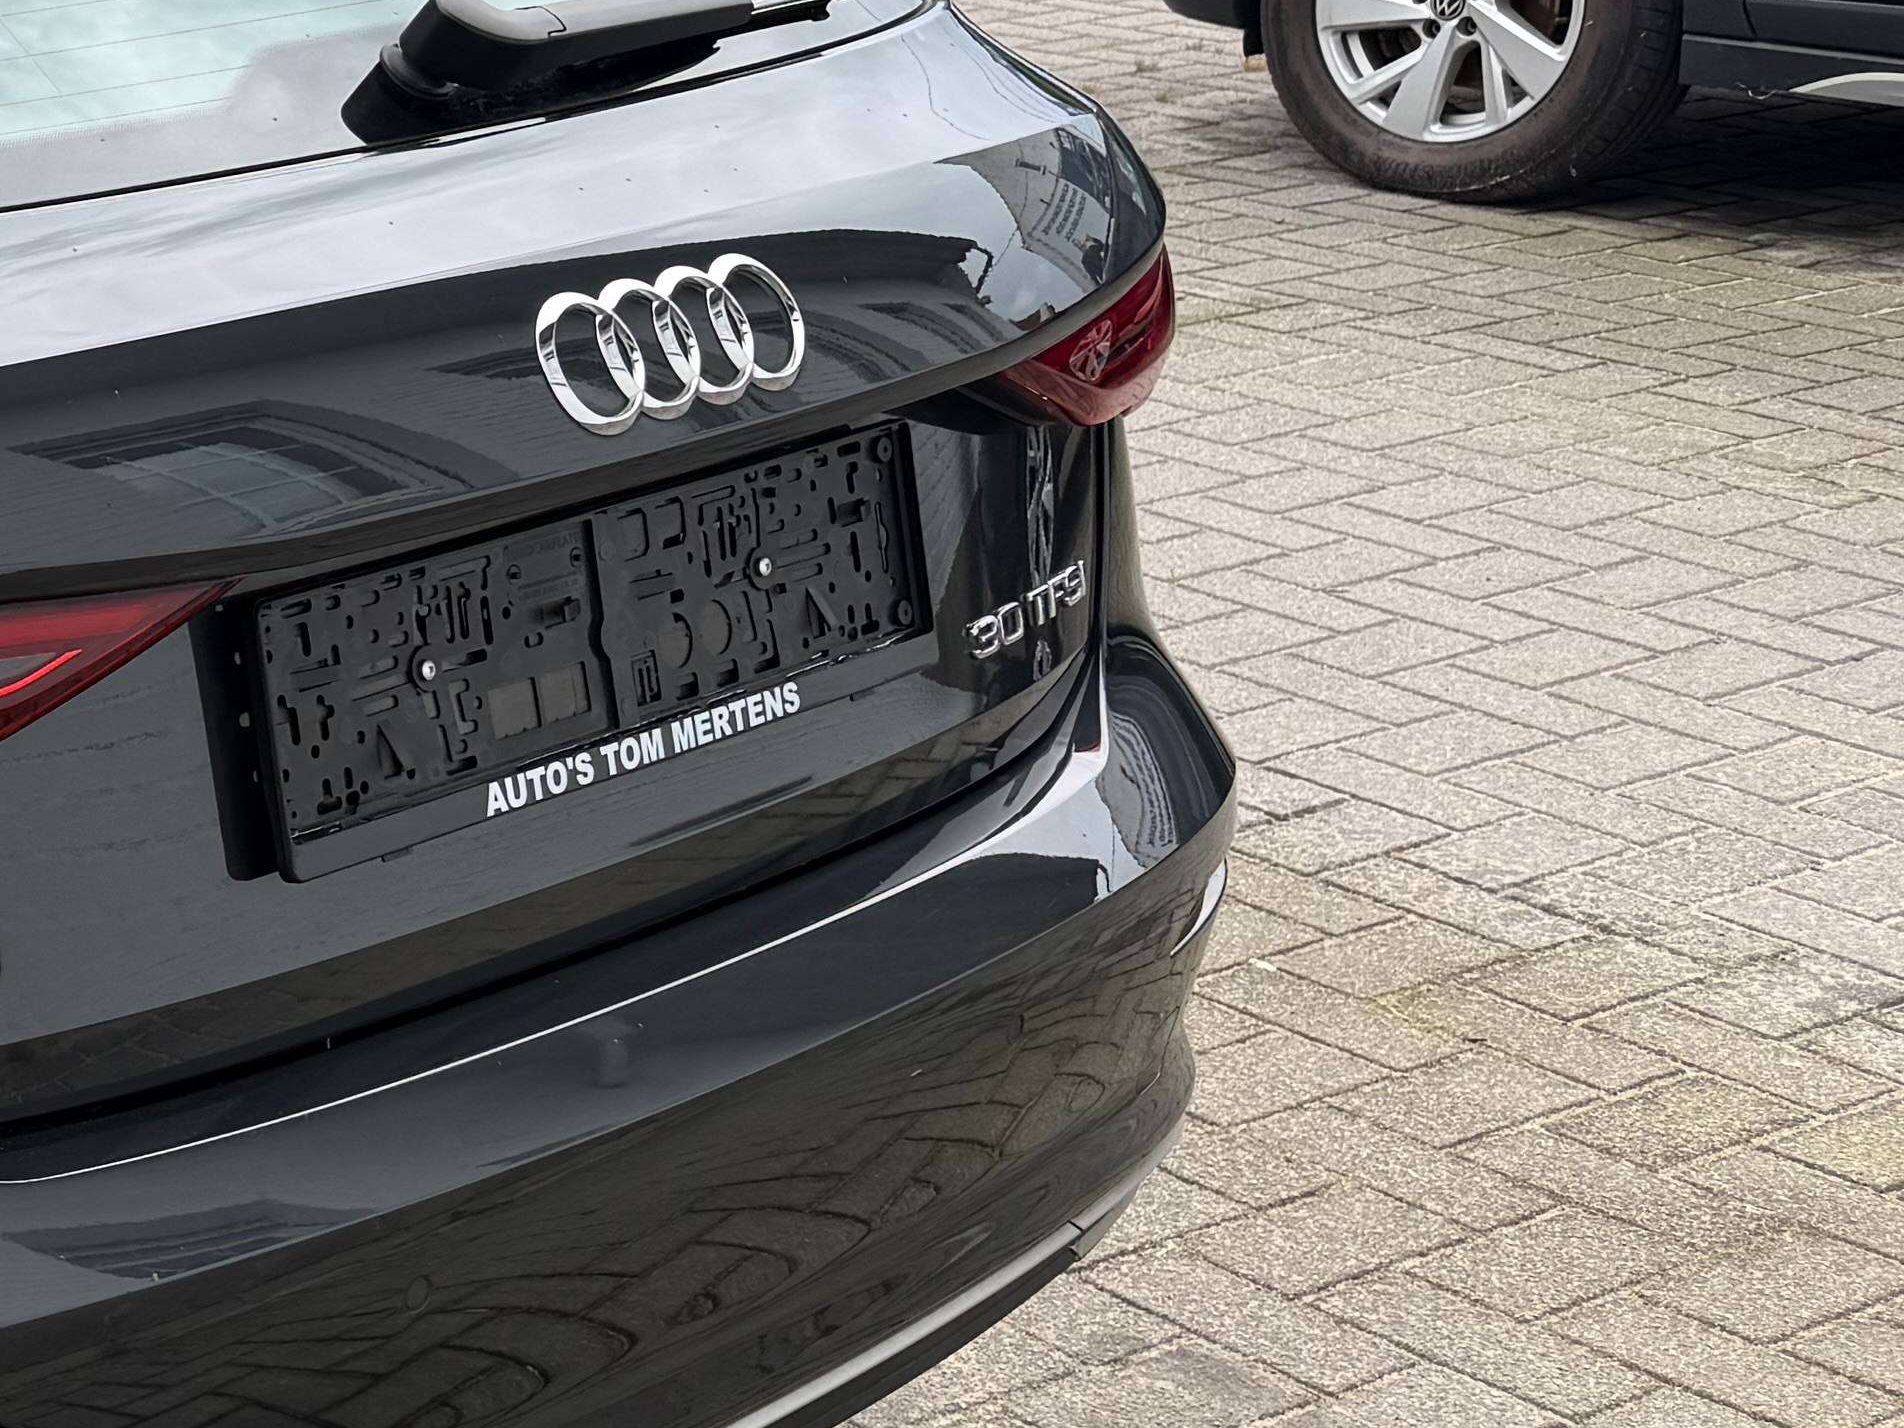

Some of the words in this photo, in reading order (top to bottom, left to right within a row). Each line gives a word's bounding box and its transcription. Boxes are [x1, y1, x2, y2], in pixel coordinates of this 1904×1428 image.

[962, 601, 1025, 660] 30
[486, 752, 595, 818] AUTO'S
[600, 727, 667, 777] TOM
[670, 681, 801, 754] MERTENS
